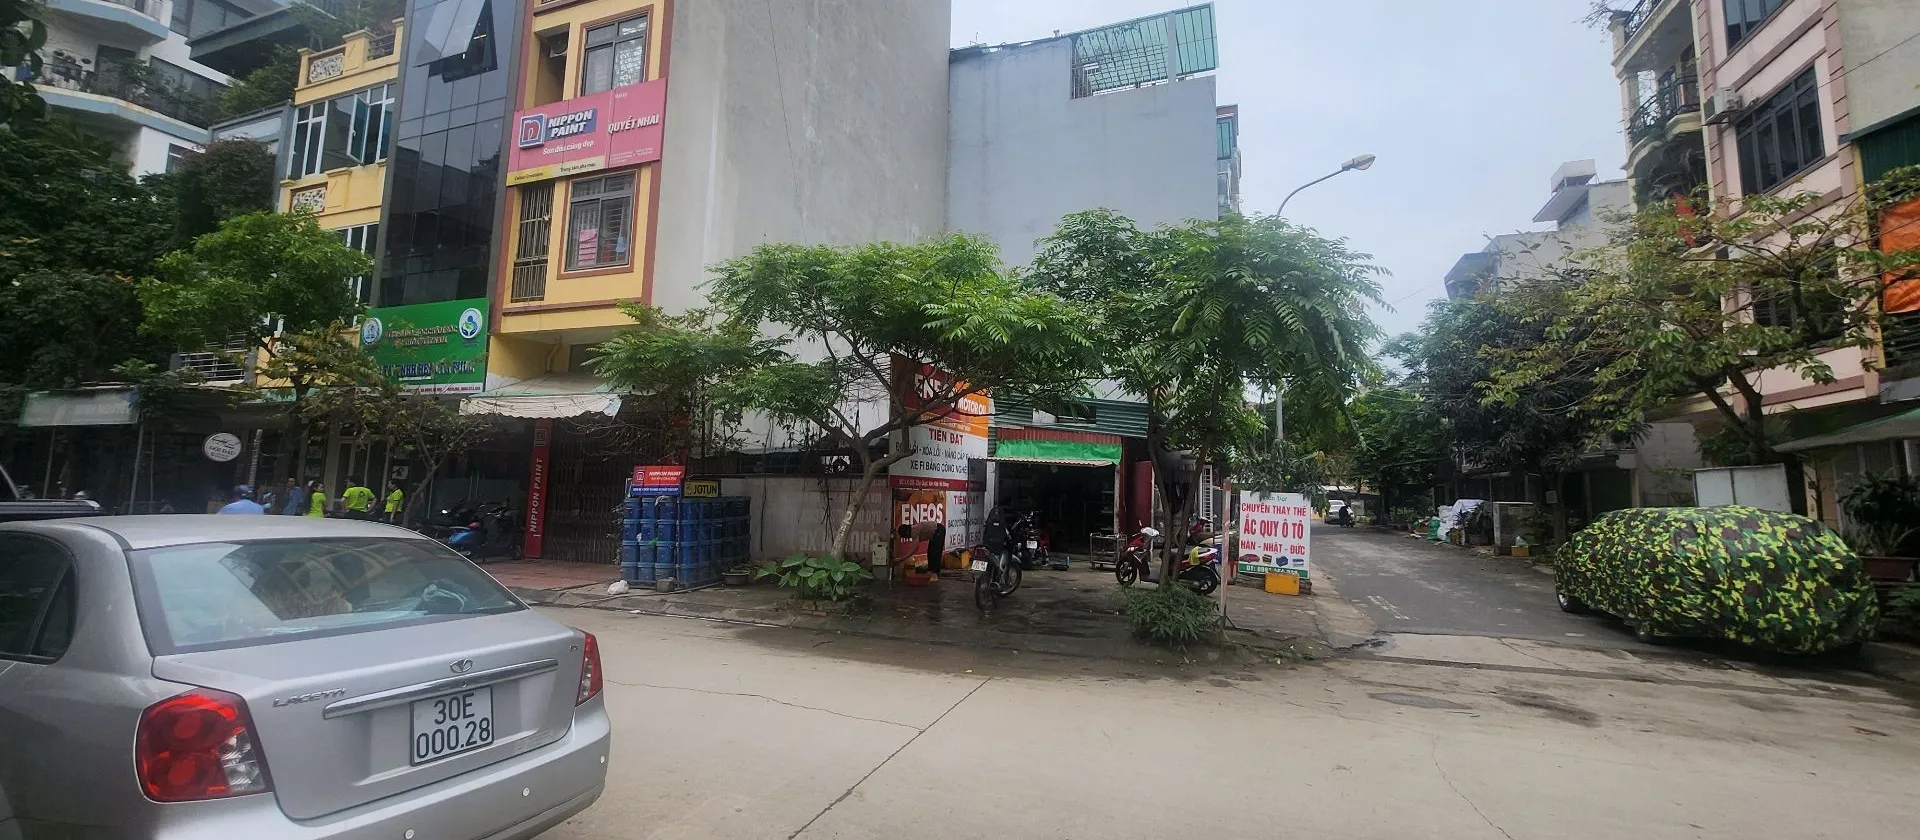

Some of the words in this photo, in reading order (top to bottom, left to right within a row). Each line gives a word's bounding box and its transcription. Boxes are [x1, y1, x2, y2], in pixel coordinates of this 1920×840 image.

[548, 109, 593, 128] NIPPON
[608, 115, 637, 134] QUYẾT
[550, 122, 586, 138] PAINT
[928, 426, 947, 442] TIẾN
[534, 458, 543, 490] PAINT
[911, 460, 918, 470] XE
[693, 485, 716, 495] JOTUN
[529, 493, 540, 532] NIPPON
[901, 503, 943, 526] ENEOS
[1241, 502, 1270, 514] CHUYÊN
[1272, 505, 1291, 515] THAY
[1293, 504, 1308, 517] THẾ
[1244, 514, 1257, 536] ẮC
[1260, 520, 1279, 538] QUY
[1282, 518, 1288, 538] Ô
[1292, 520, 1304, 540] TÔ
[1240, 539, 1256, 550] HÀN
[1263, 541, 1282, 555] NHẬT
[1290, 543, 1305, 555] ĐỨC
[433, 692, 475, 725] 30E
[416, 716, 491, 760] 000.28
